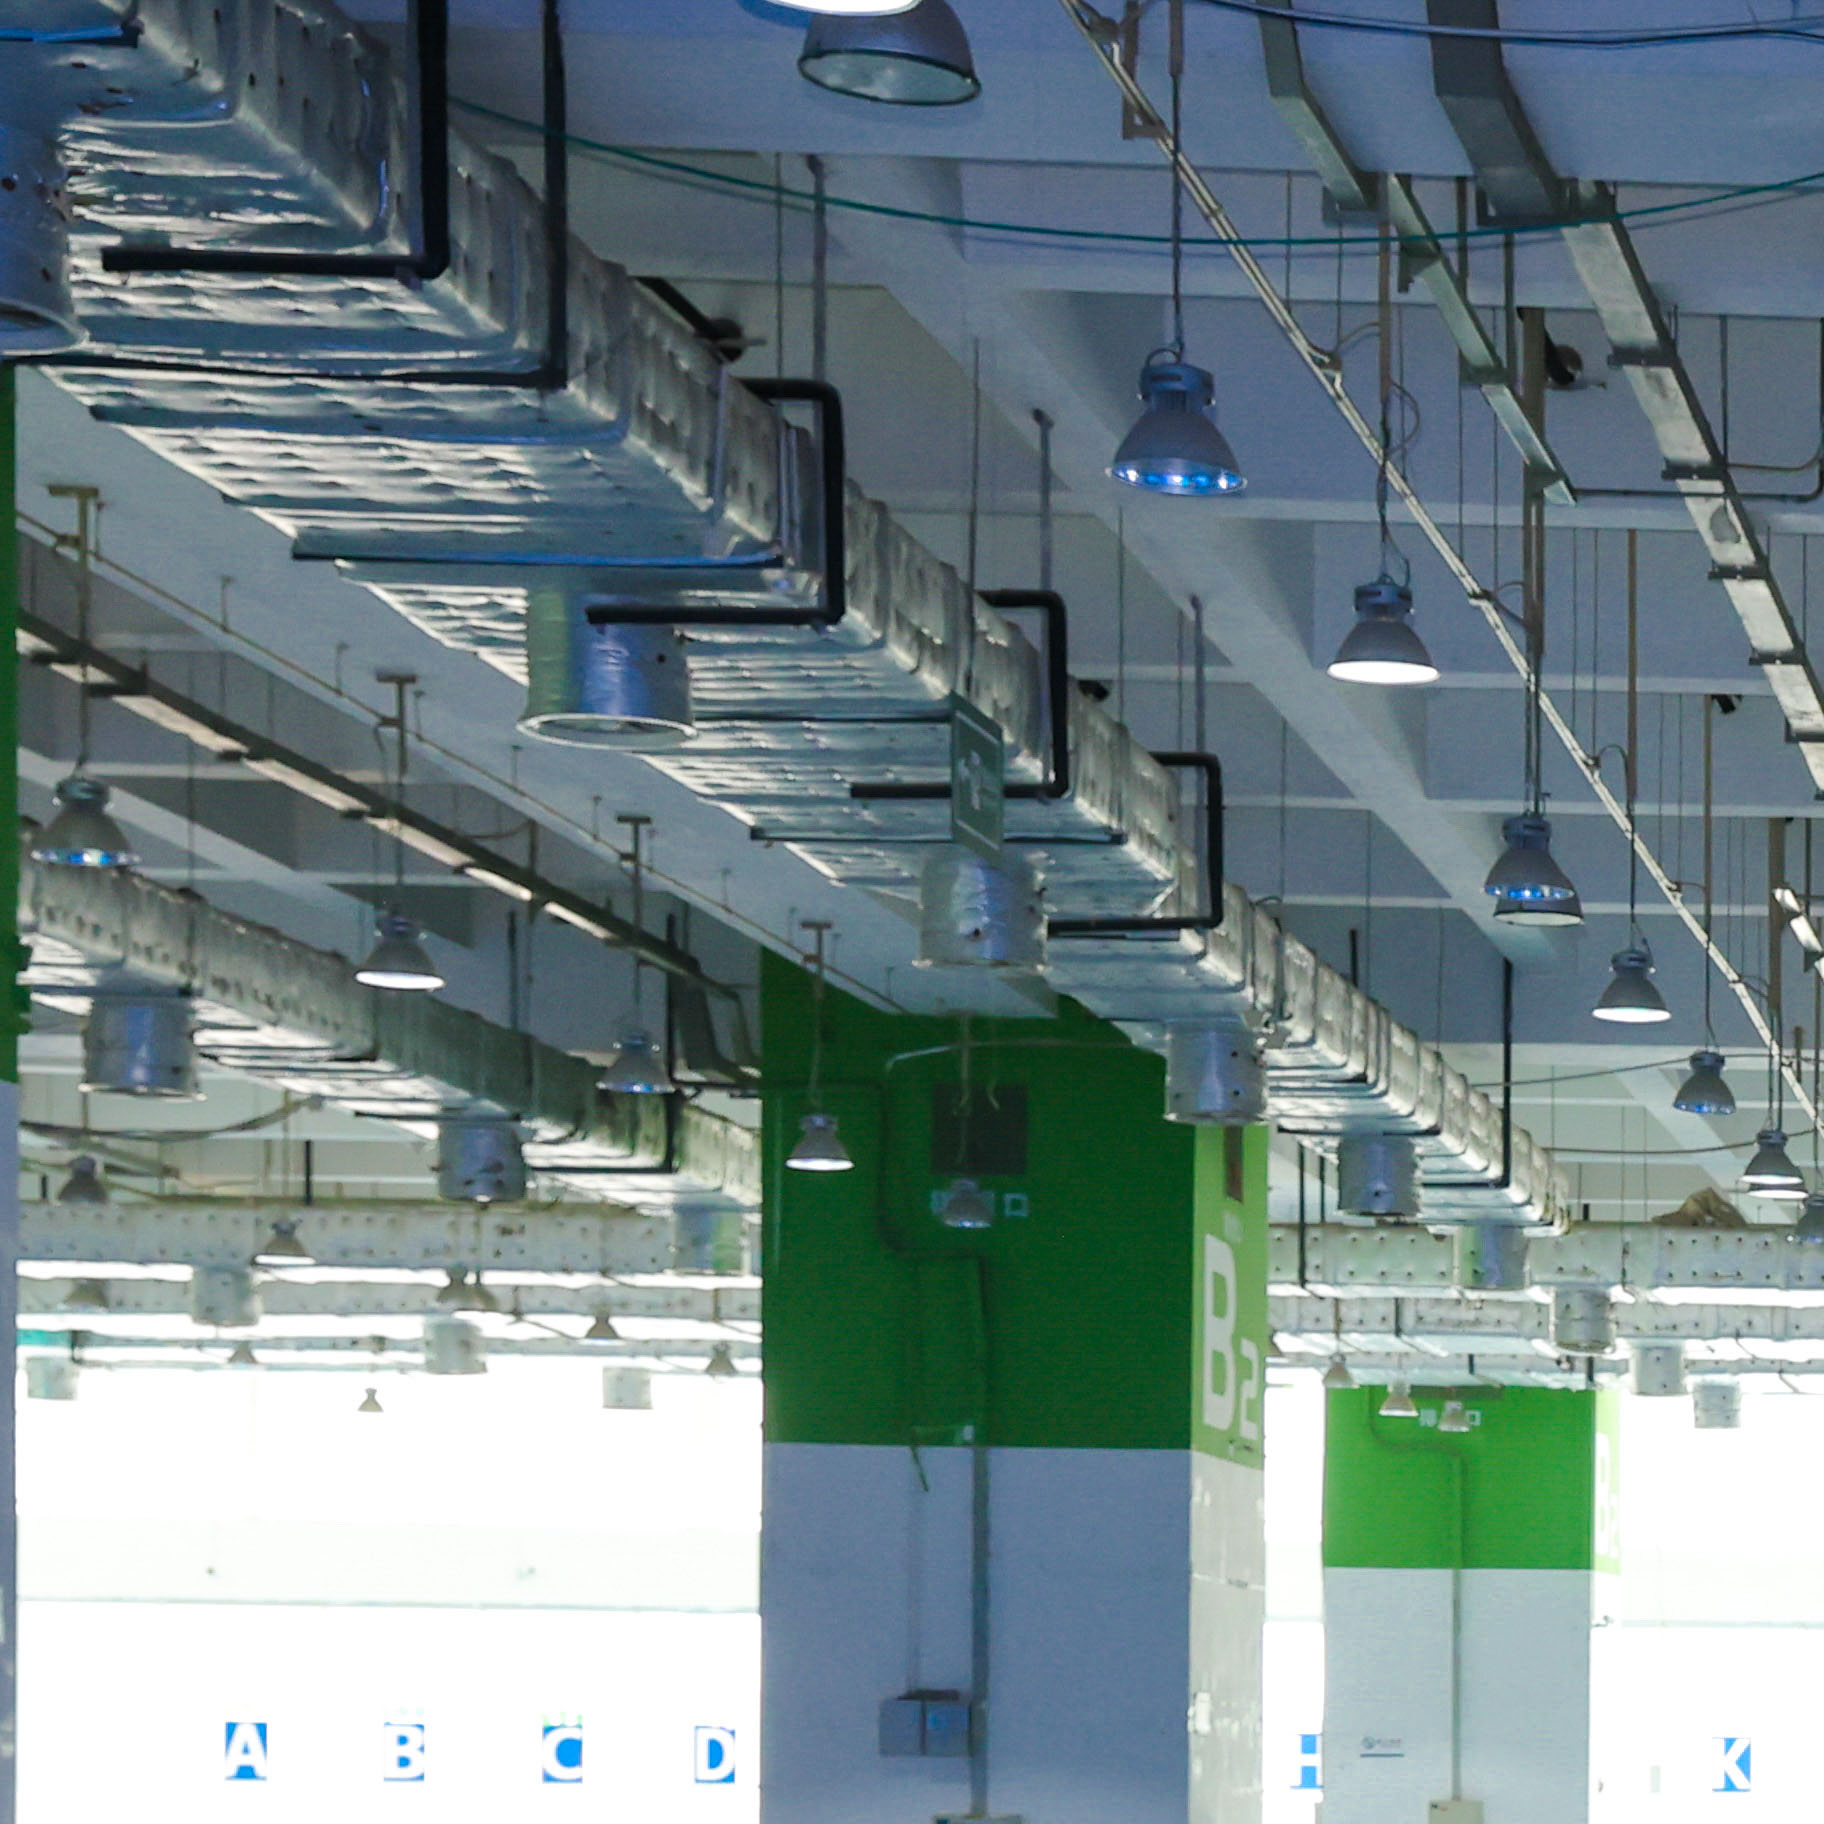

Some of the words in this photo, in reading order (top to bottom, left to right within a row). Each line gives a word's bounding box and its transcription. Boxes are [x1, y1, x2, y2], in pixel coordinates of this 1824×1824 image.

[1204, 1233, 1259, 1440] B2
[225, 1722, 267, 1780] A
[384, 1723, 424, 1781] B
[542, 1726, 582, 1783] C
[694, 1726, 734, 1783] D
[1712, 1737, 1751, 1792] K
